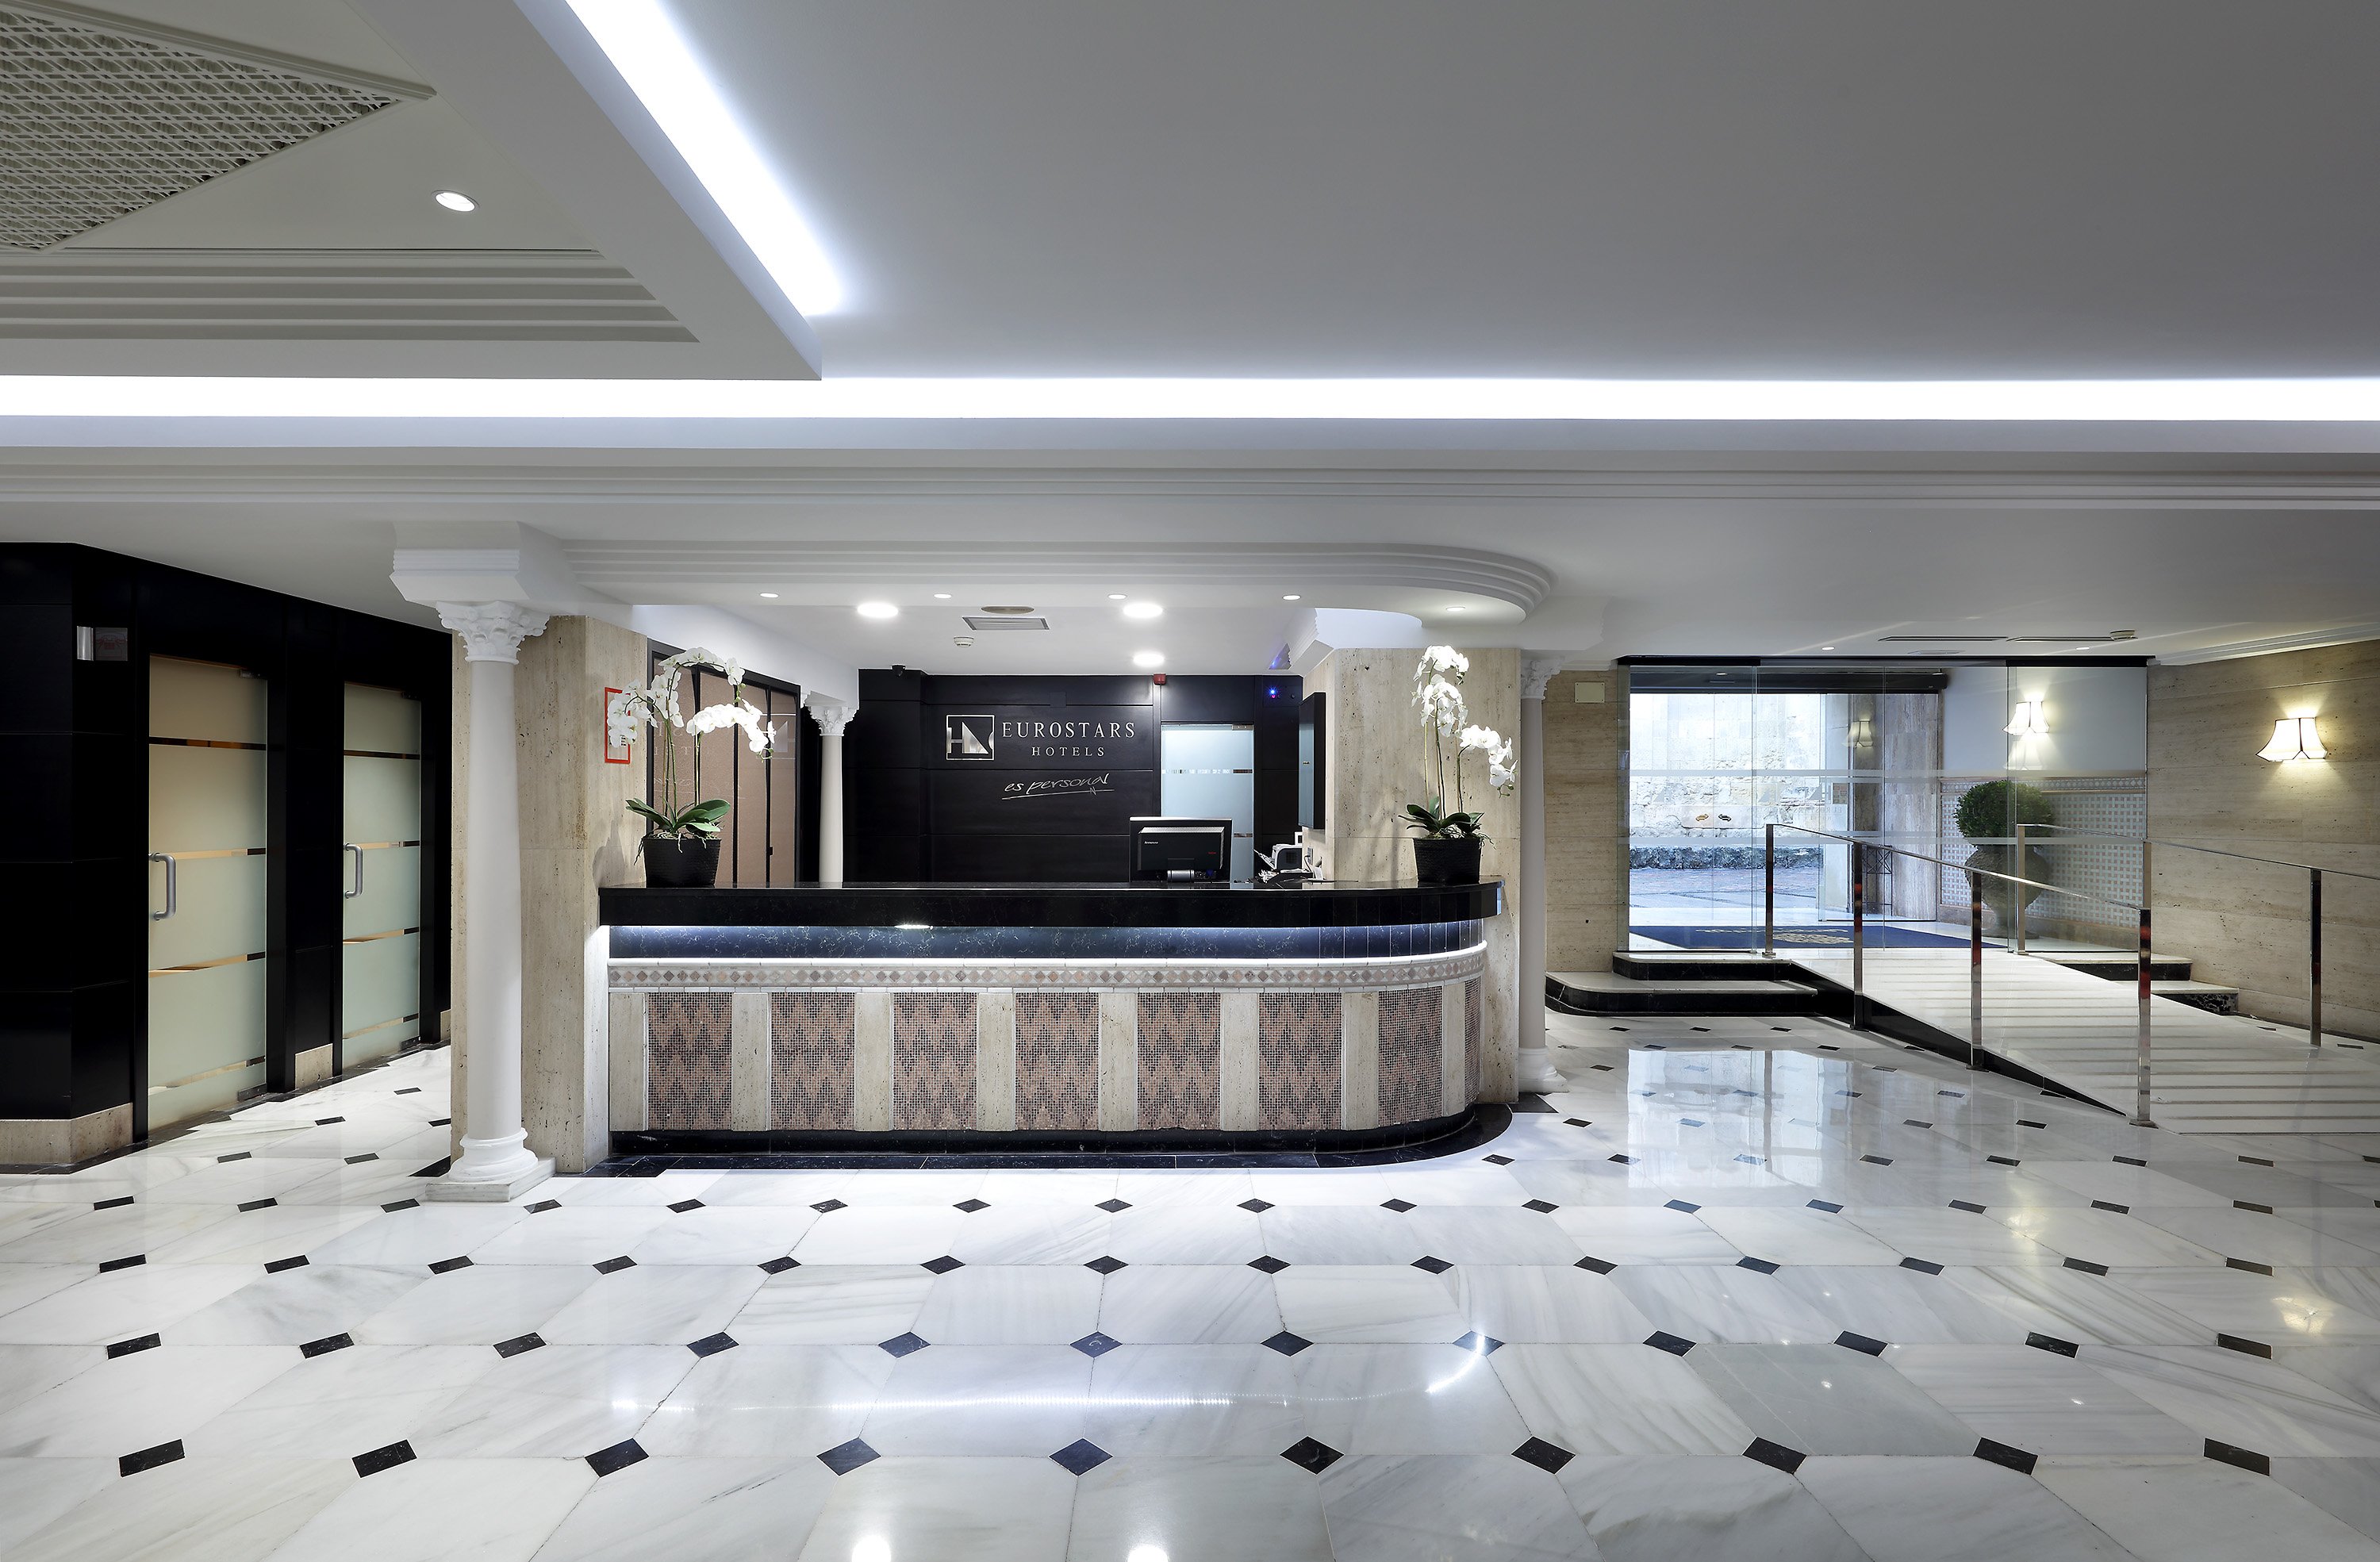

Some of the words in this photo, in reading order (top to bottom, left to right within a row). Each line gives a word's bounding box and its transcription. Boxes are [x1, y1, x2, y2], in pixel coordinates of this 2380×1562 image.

[1002, 722, 1135, 739] EUROSTARS
[1031, 746, 1105, 757] HOTELS
[1004, 781, 1025, 793] es
[1026, 773, 1110, 795] personal
